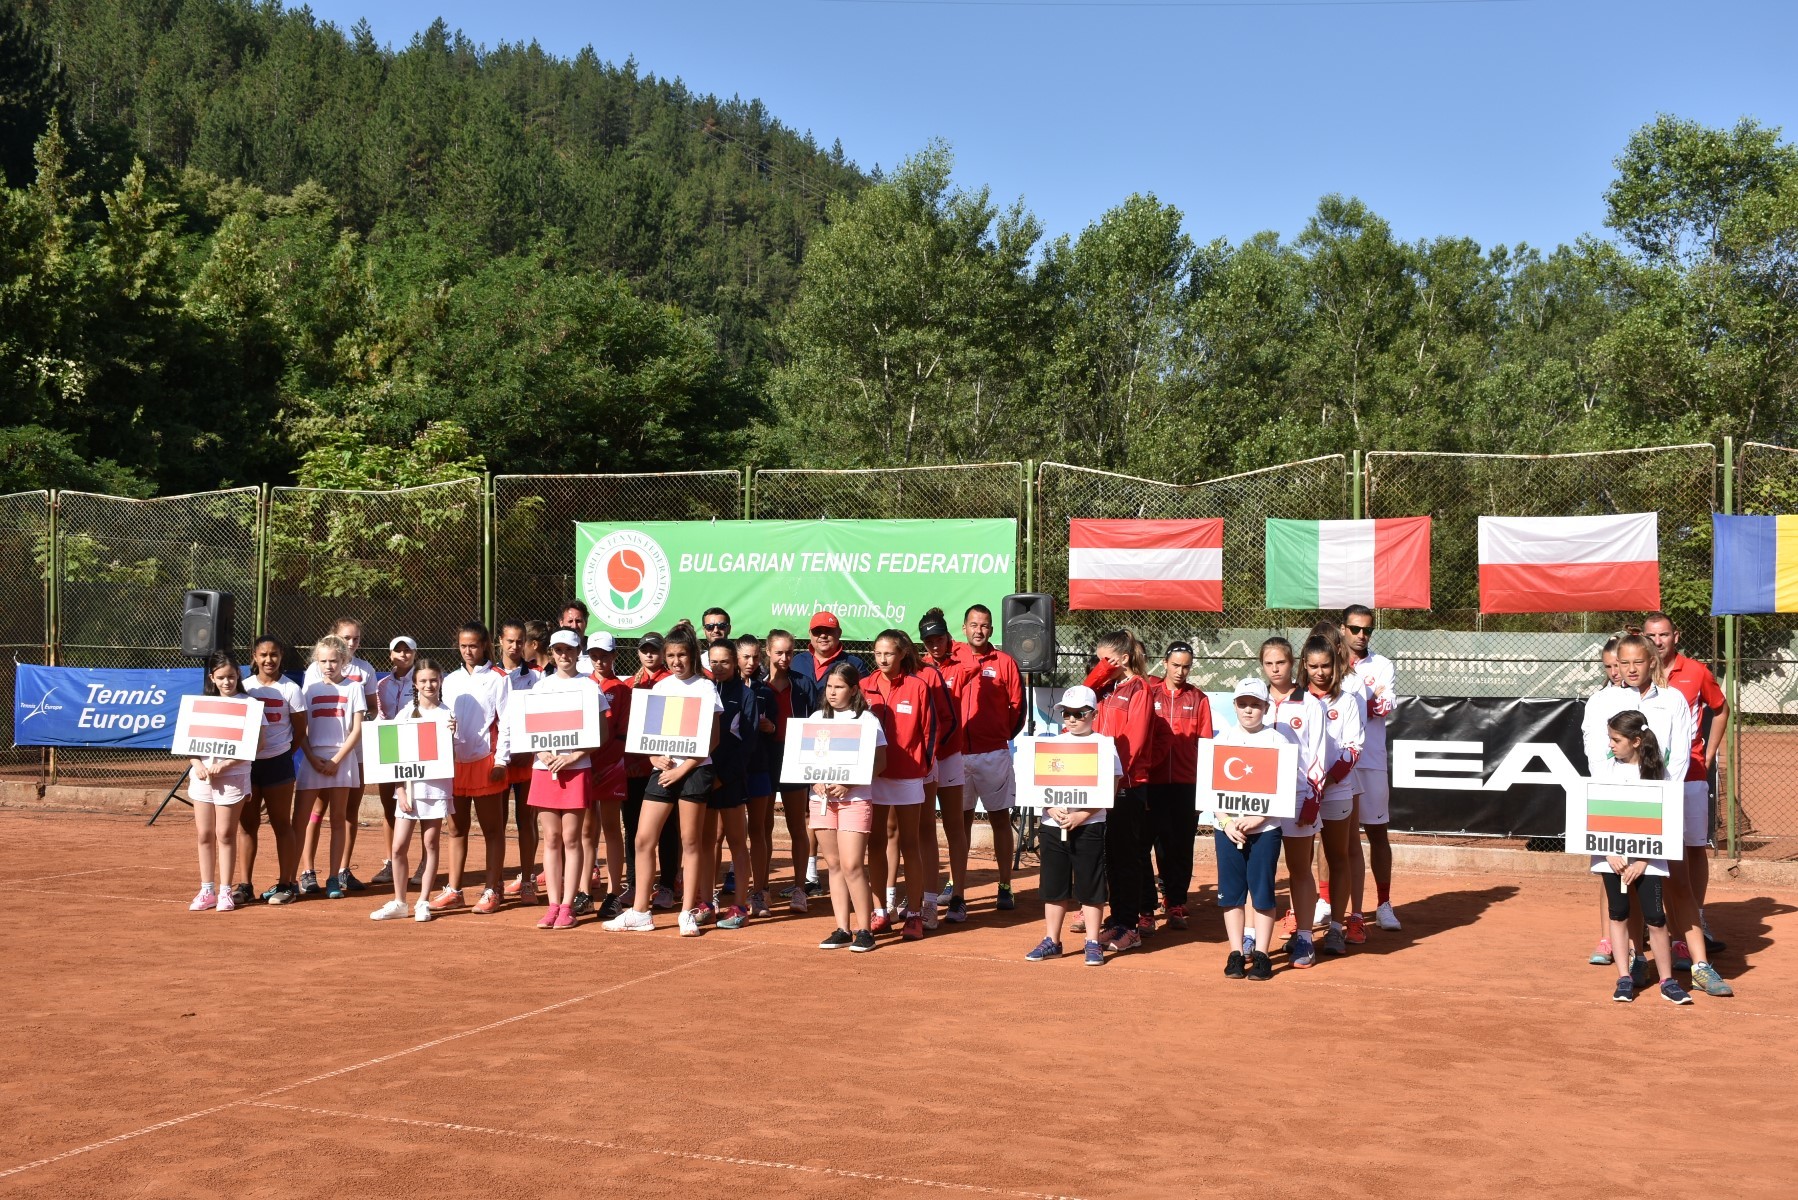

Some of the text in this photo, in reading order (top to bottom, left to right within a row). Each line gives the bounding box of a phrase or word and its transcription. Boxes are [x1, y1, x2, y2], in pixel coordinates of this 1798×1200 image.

[587, 534, 667, 608] BULGARIAN TENNIS FEDERATION
[679, 552, 1010, 574] BULGARIAN TENNIS FEDERATION
[618, 617, 633, 625] 1930
[1396, 651, 1539, 675] ПИРИНСКО
[86, 683, 167, 705] Tennis
[78, 708, 166, 733] Europe
[189, 739, 237, 756] Austria
[531, 731, 579, 749] Poland
[640, 736, 697, 754] Romania
[394, 763, 425, 779] Italy
[803, 765, 850, 781] Serbia
[1392, 739, 1592, 792] EA
[1044, 787, 1088, 806] Spain
[1217, 792, 1270, 814] Turkey
[1585, 833, 1663, 856] Bulgaria
